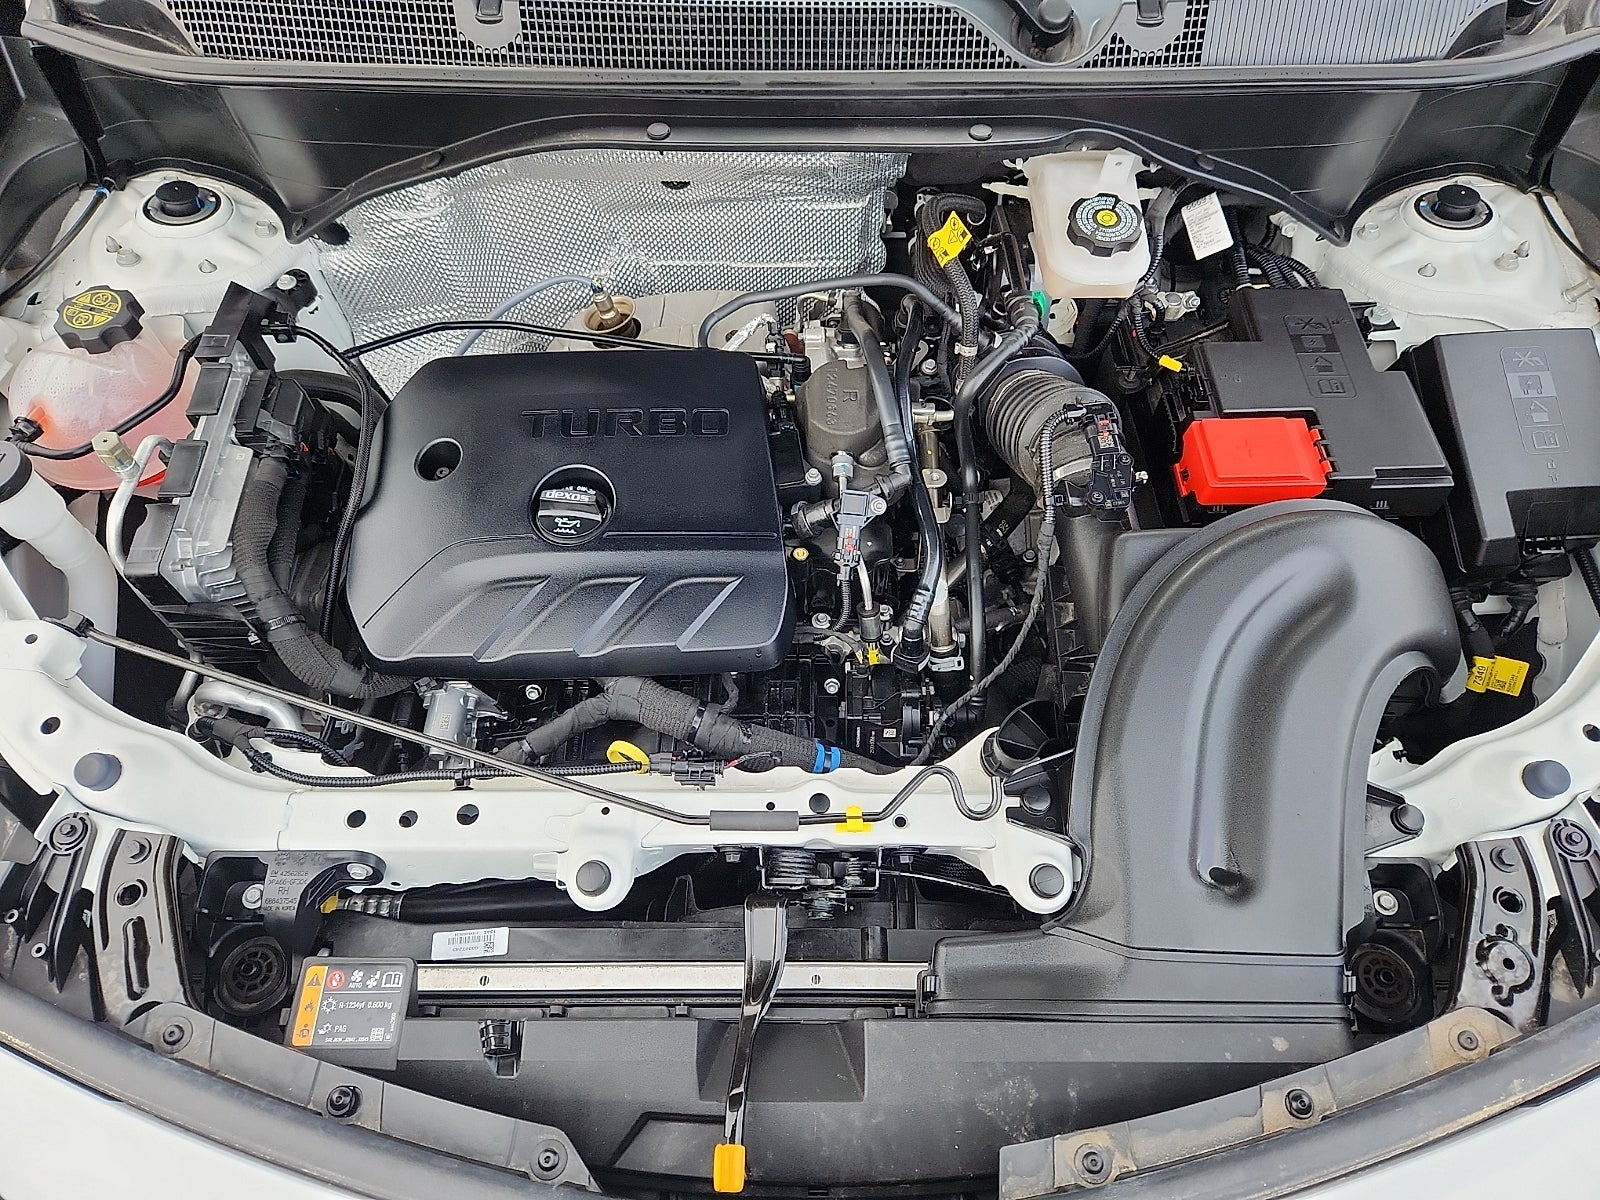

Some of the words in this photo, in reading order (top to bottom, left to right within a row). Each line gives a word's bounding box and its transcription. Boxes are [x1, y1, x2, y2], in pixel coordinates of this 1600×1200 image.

[842, 389, 859, 402] R
[521, 407, 731, 439] TURBO
[546, 489, 591, 502] dexos
[1472, 665, 1487, 686] 7349
[278, 886, 290, 895] RH
[384, 1002, 393, 1010] kg
